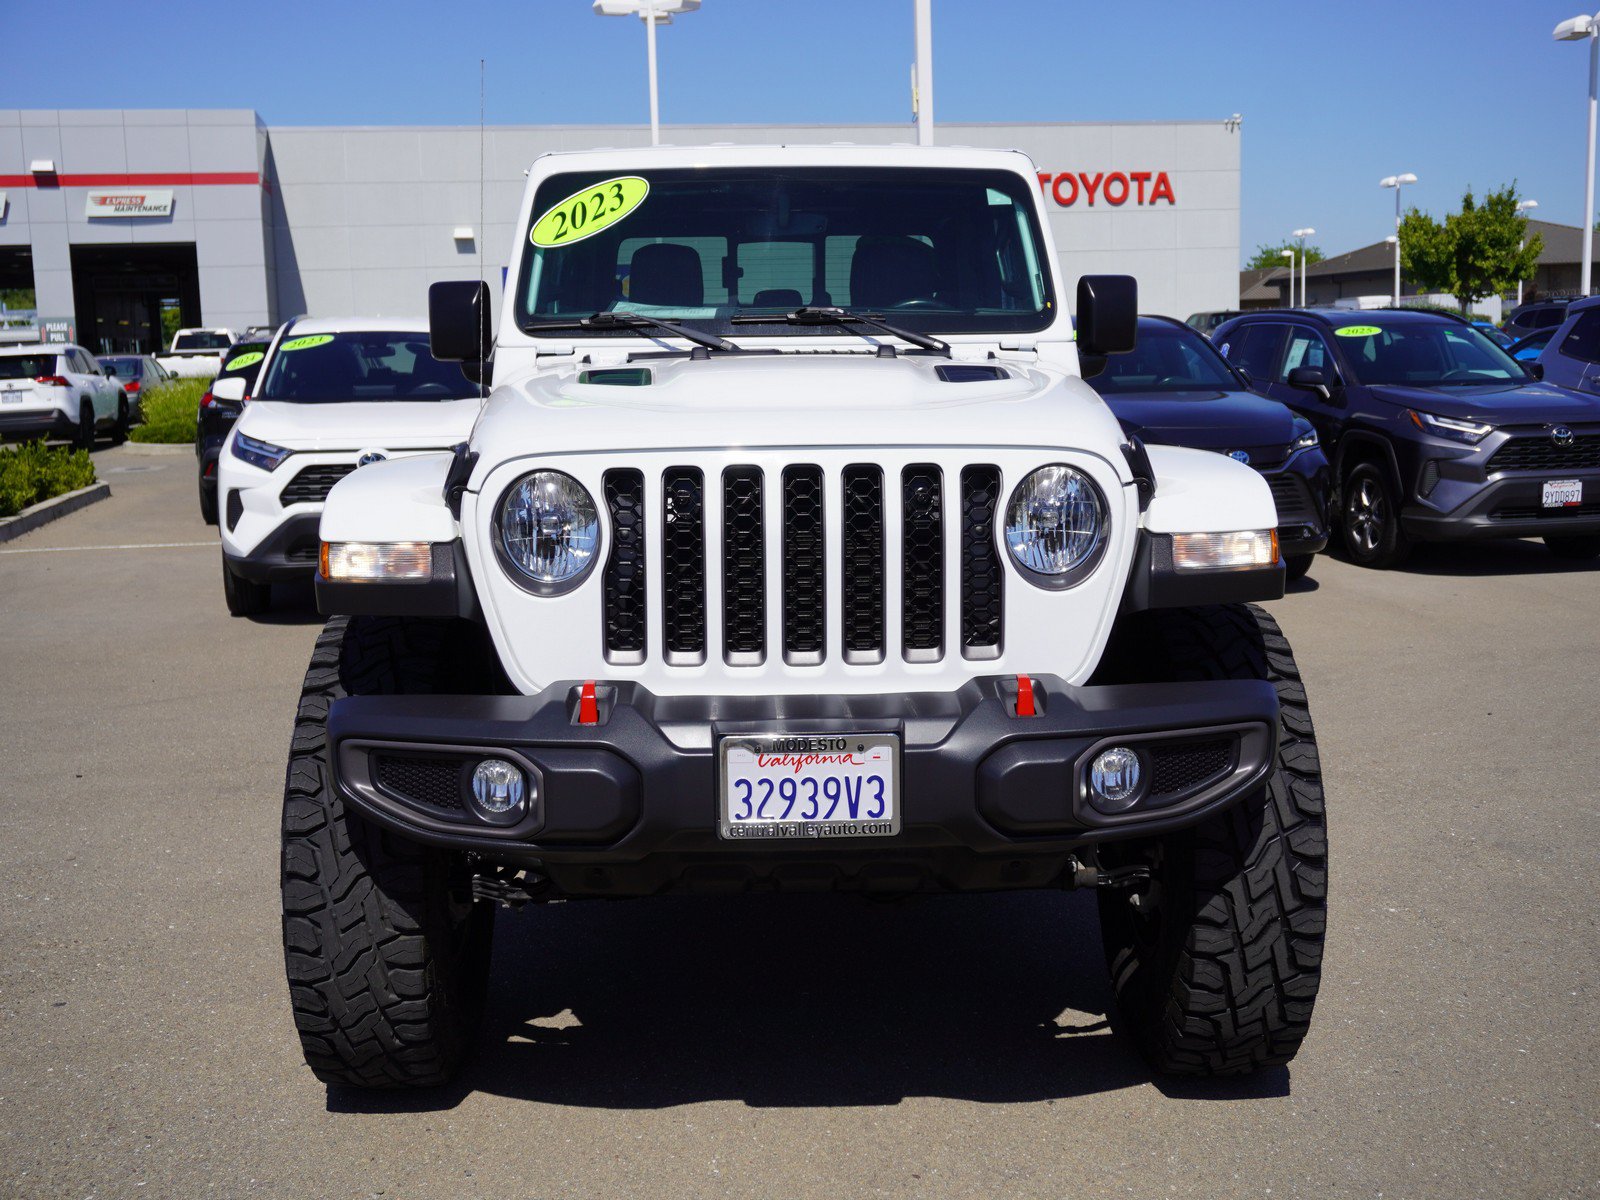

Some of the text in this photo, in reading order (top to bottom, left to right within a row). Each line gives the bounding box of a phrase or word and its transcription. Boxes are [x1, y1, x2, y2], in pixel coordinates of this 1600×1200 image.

[105, 196, 141, 205] EXPRESS
[114, 205, 168, 213] MAINTENANCE
[552, 183, 625, 242] 2023
[46, 322, 68, 331] PLEASE
[50, 332, 65, 342] PULL
[772, 737, 847, 752] MODESTO
[758, 752, 865, 774] California
[734, 775, 885, 820] 32939V3
[729, 821, 892, 838] centralvalleyauto.com
